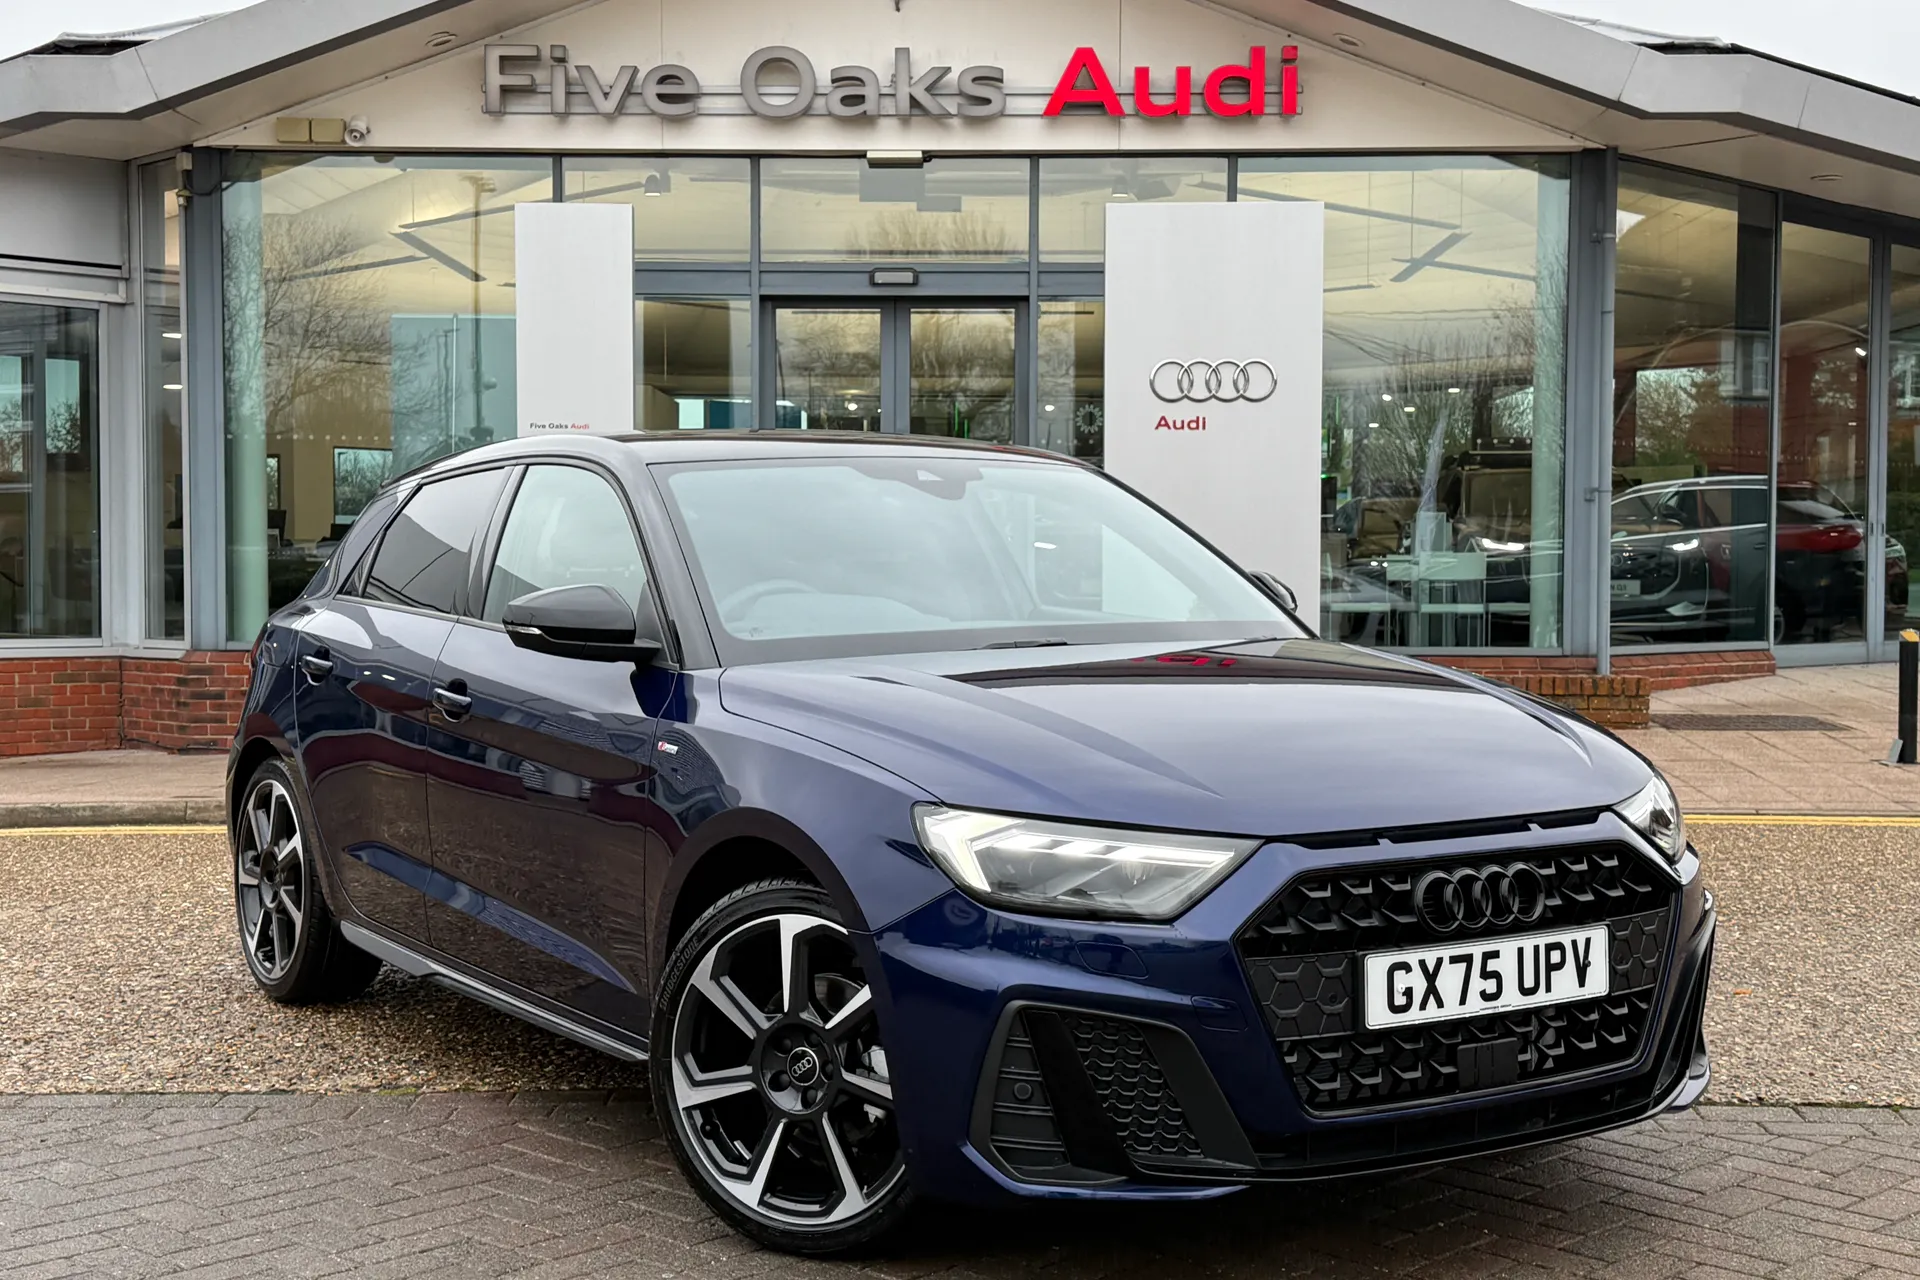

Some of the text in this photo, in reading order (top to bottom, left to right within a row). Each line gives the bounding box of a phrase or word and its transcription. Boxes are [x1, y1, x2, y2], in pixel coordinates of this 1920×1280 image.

[484, 44, 1299, 119] Five Oaks Audi
[529, 422, 590, 430] Five Oaks Audi
[1154, 415, 1207, 431] Audi
[1386, 936, 1592, 1015] GX75 UPV
